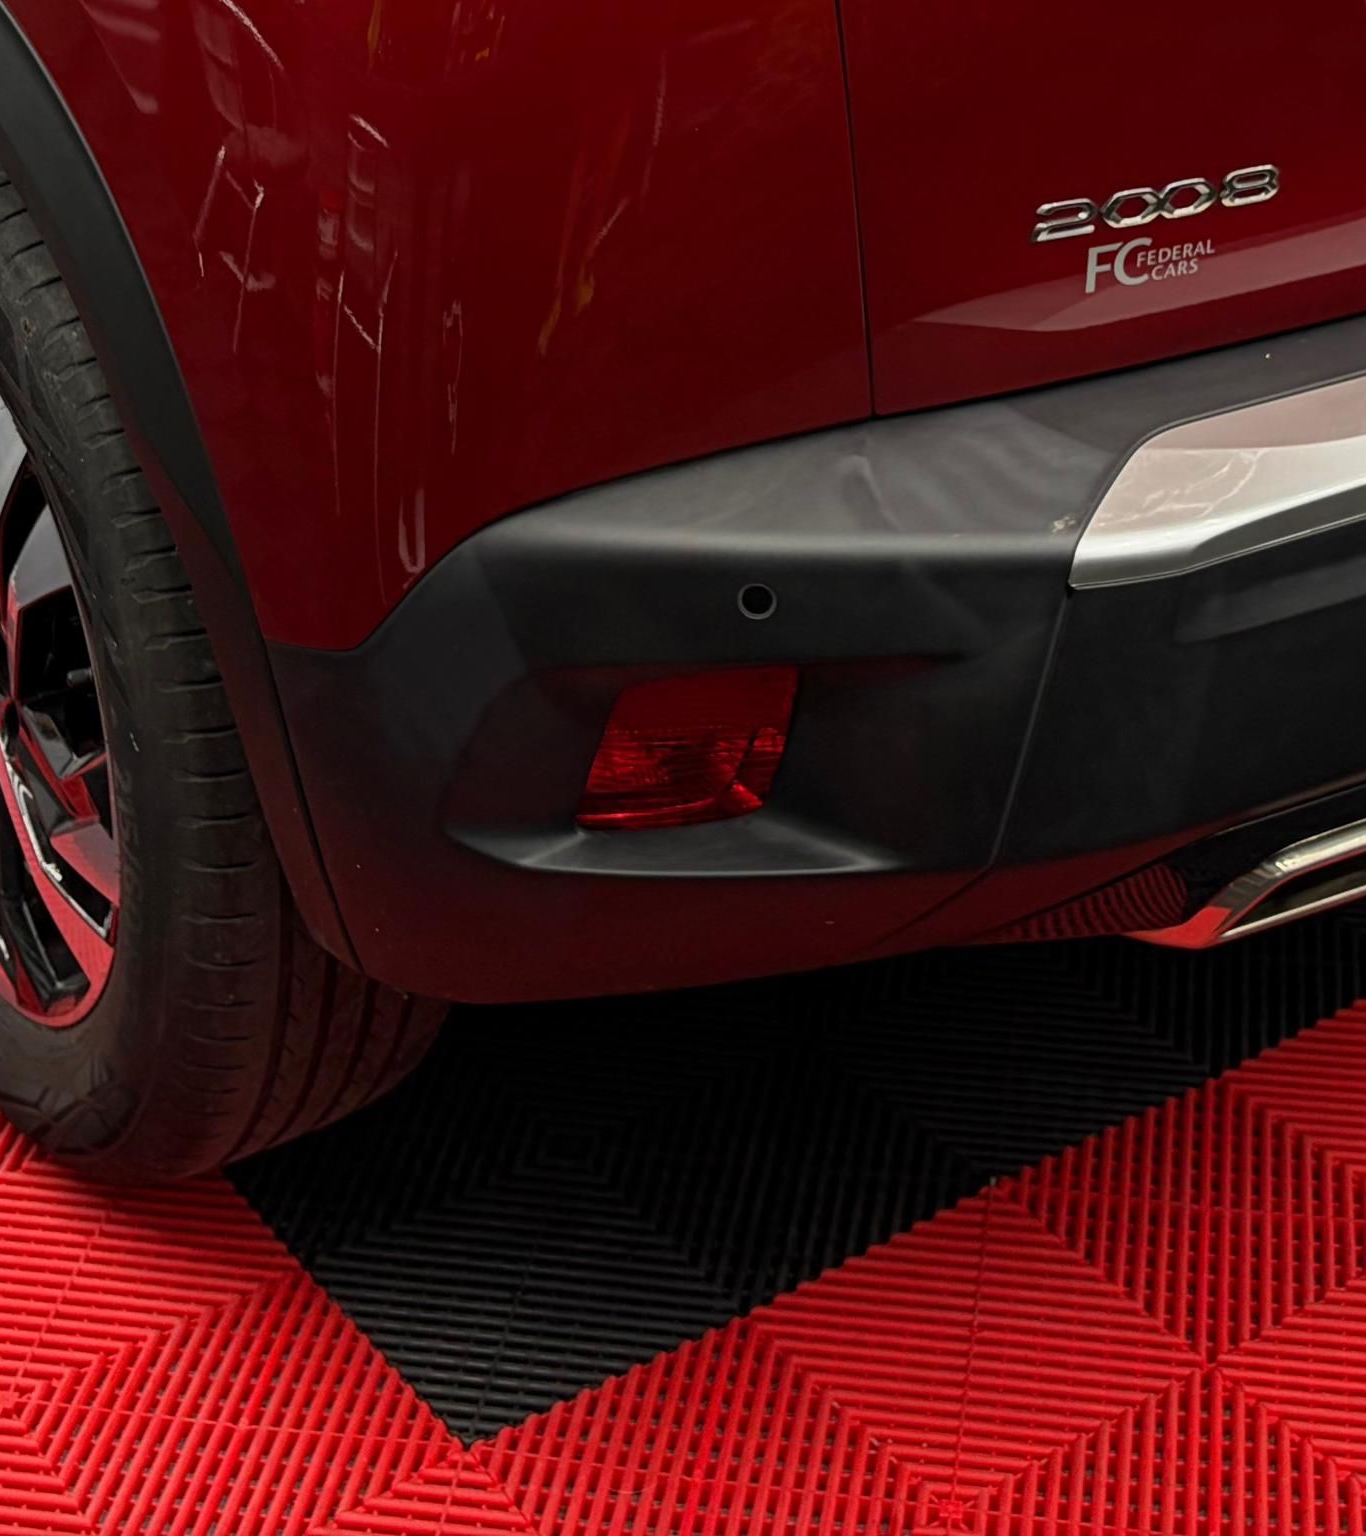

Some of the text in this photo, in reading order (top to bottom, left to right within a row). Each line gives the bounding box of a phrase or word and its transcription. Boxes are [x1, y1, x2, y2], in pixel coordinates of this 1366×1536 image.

[1031, 163, 1280, 242] 2008
[1085, 237, 1153, 294] FC
[1136, 238, 1216, 267] FEDERAL
[1150, 258, 1199, 281] CARS
